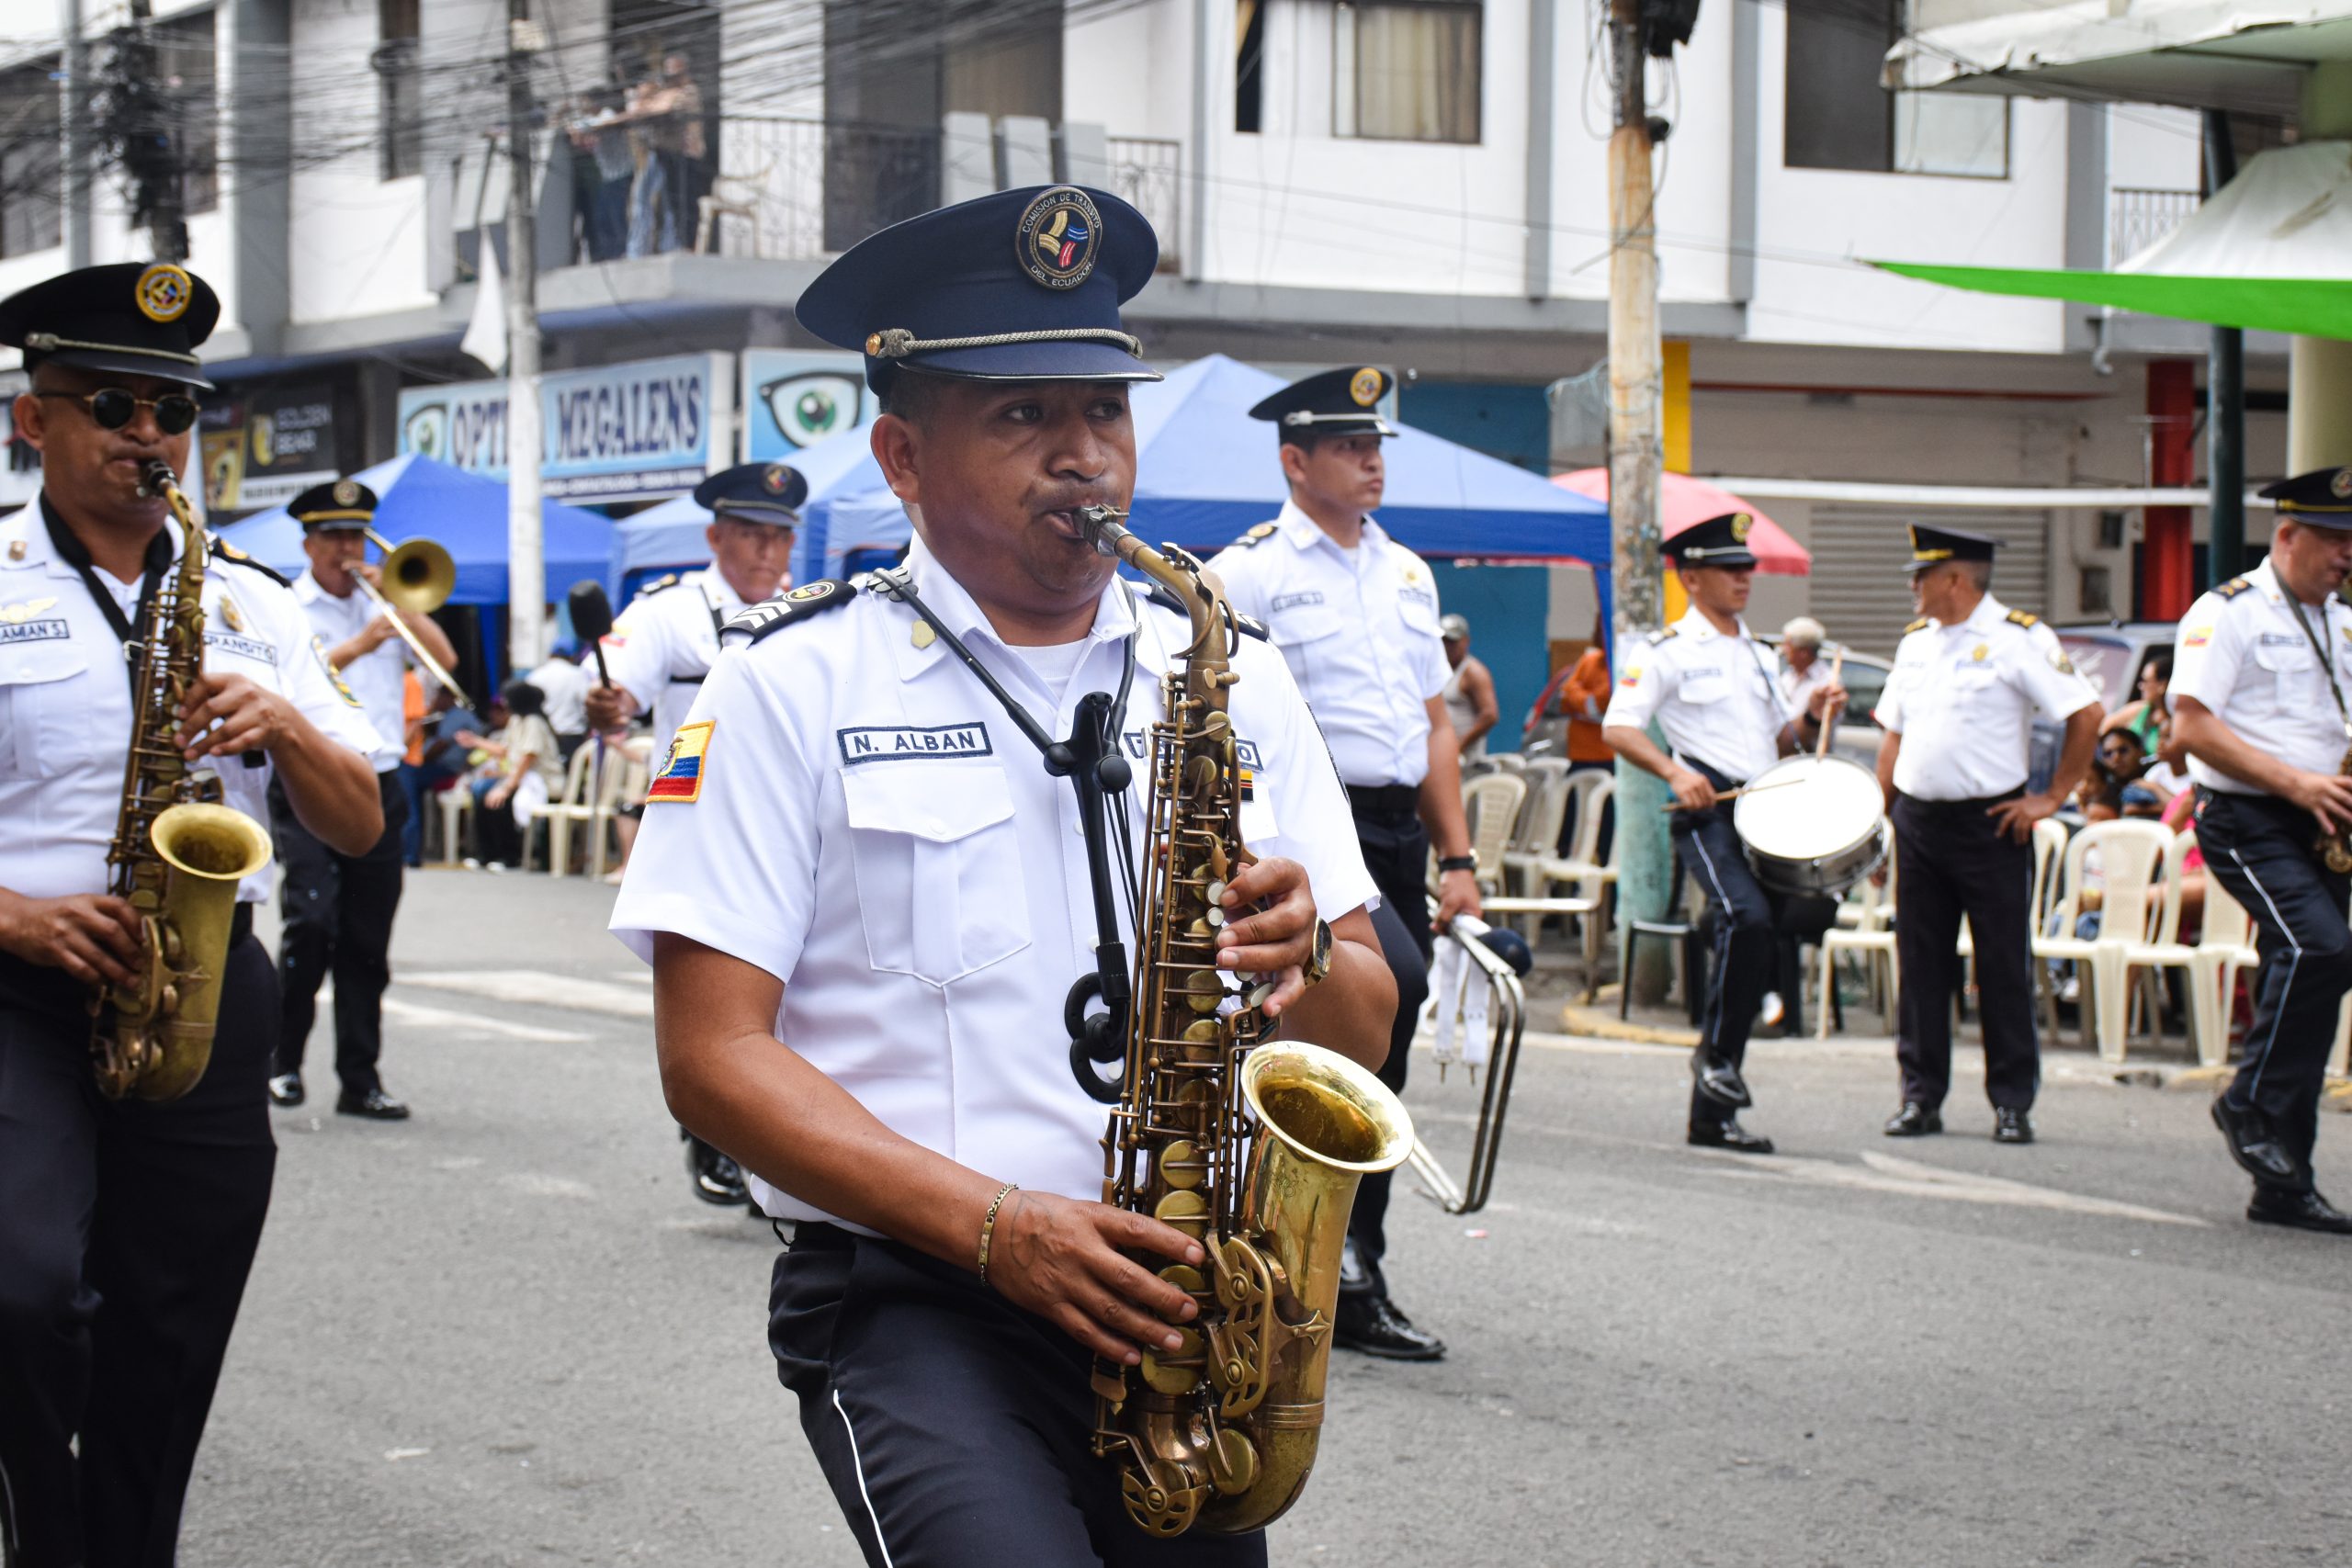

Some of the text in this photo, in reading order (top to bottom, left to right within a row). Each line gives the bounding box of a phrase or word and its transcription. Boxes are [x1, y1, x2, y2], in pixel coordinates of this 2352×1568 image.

[1022, 193, 1101, 233] COMISION DE TRANSITO
[1030, 261, 1093, 287] DEL ECUADOR
[453, 374, 702, 468] OPTI MEGALENS
[854, 730, 976, 754] N. ALBAN
